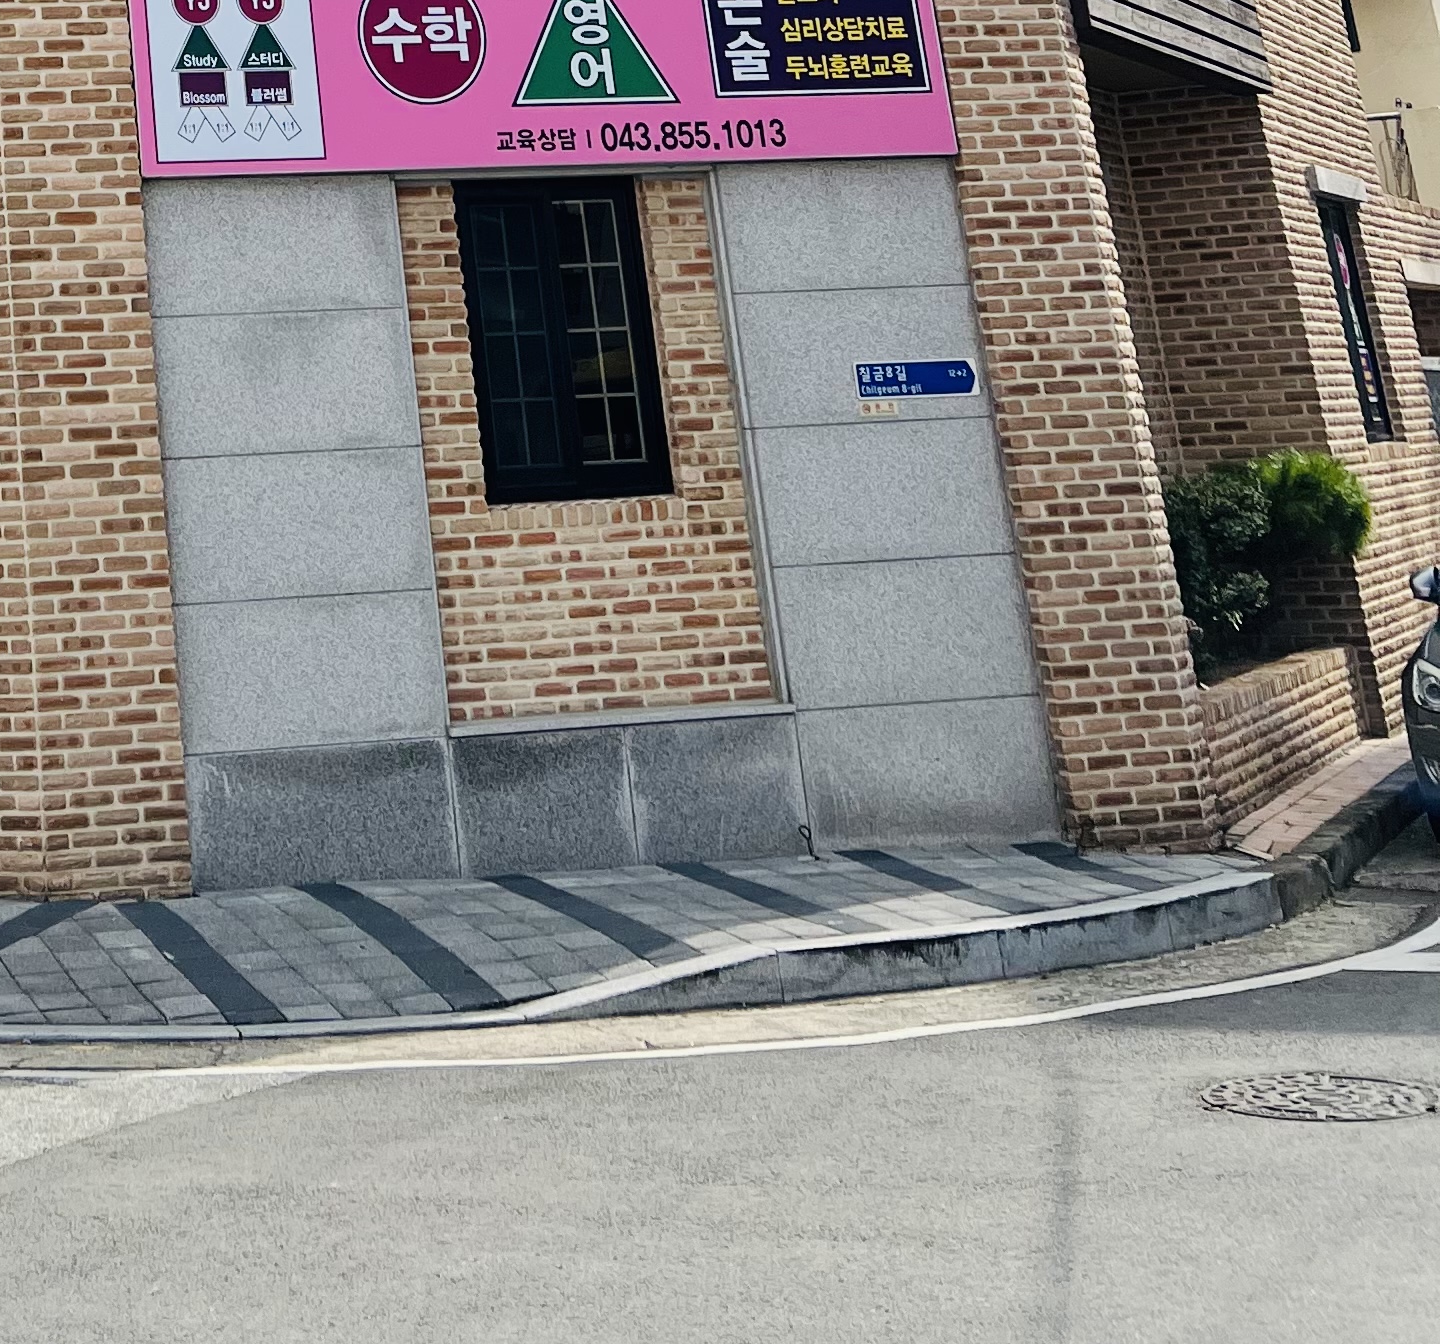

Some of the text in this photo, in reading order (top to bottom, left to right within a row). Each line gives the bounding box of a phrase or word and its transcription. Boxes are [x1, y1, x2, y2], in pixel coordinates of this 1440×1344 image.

[371, 6, 472, 63] 수학
[780, 16, 909, 42] 심리상담치료
[183, 53, 218, 69] Study
[247, 51, 284, 66] 스터디
[786, 52, 914, 80] 두뇌훈련교육
[182, 91, 226, 104] Blossom
[251, 87, 288, 103] 블러썸
[496, 118, 787, 152] 교육상담 043.855.1013
[858, 365, 908, 383] 칠금8길
